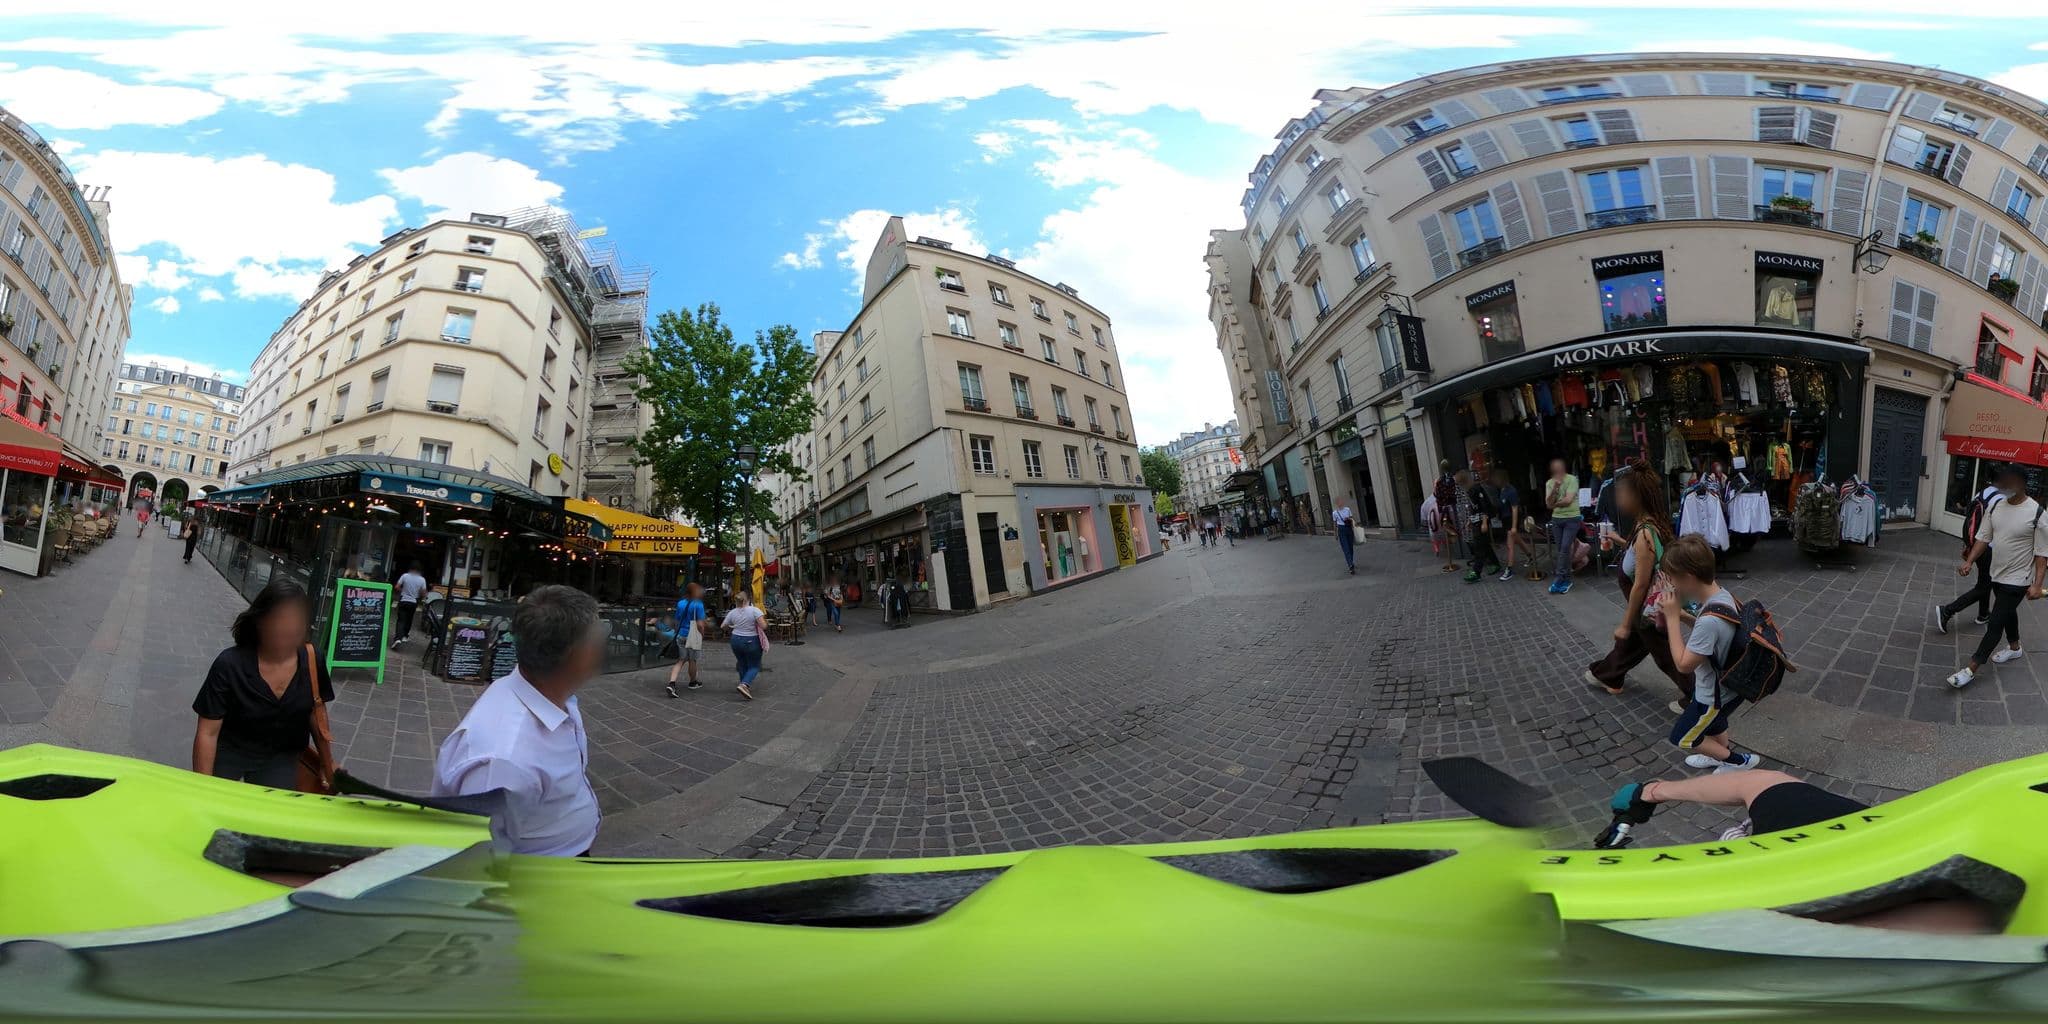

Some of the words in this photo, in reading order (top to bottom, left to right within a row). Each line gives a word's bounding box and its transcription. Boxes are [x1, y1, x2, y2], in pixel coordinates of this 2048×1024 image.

[1594, 254, 1660, 270] MONARK
[1757, 255, 1821, 270] MONARK
[1467, 284, 1513, 306] MONARK
[1552, 338, 1664, 368] MONARK
[1268, 371, 1288, 421] HOTEL
[1976, 412, 2000, 422] RESTO
[1968, 423, 2014, 434] COCKTAILS
[608, 523, 639, 533] HAPPY
[641, 523, 675, 533] HOURS
[621, 541, 640, 551] EAT
[653, 542, 683, 552] LOVE
